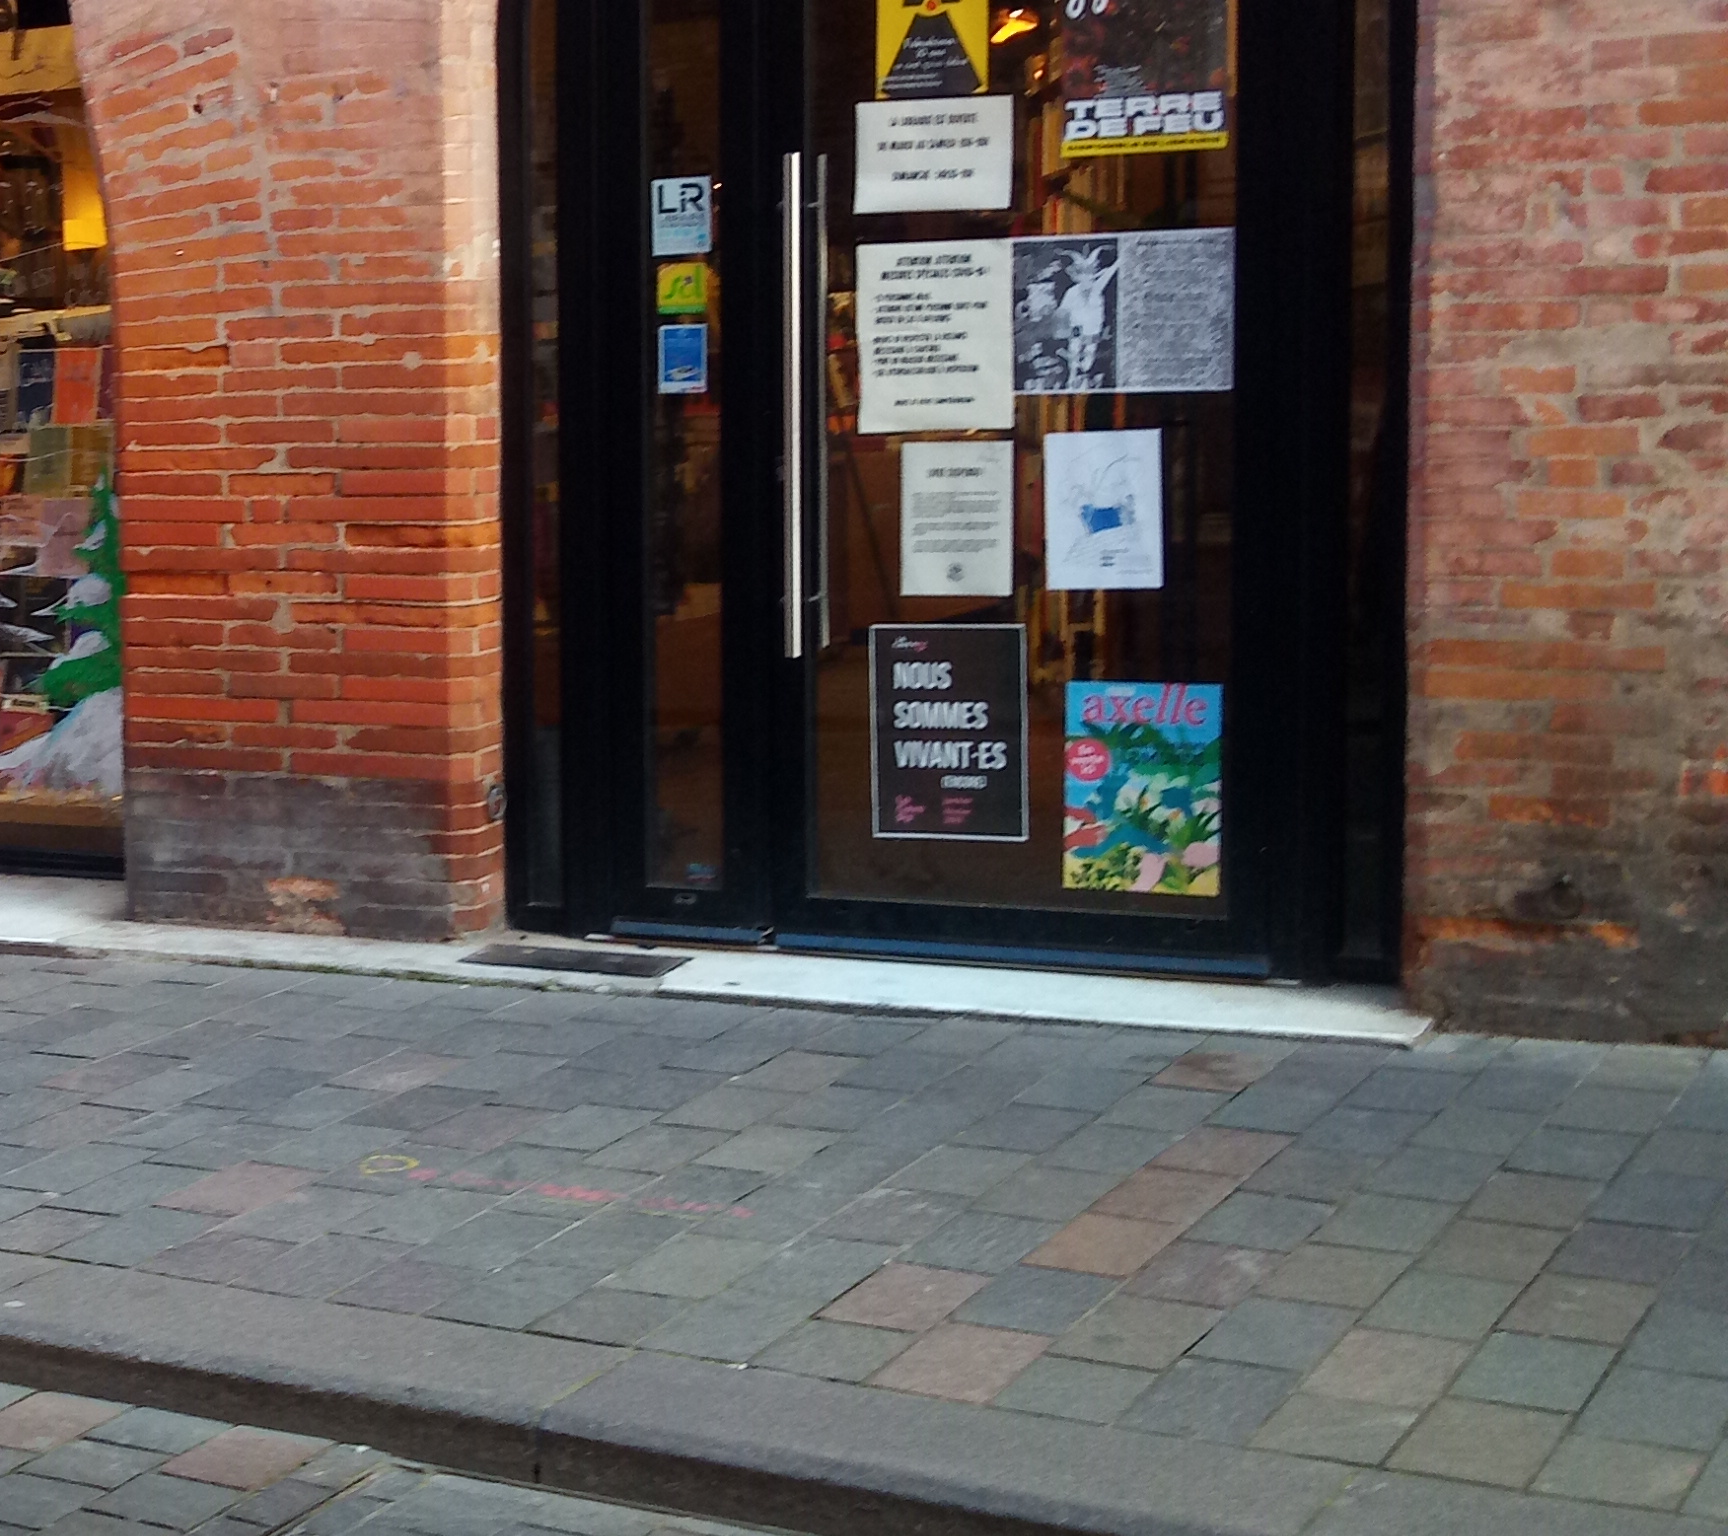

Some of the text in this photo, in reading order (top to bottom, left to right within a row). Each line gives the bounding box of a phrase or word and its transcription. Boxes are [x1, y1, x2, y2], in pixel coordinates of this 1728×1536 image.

[1065, 90, 1223, 121] TERRE
[1064, 110, 1225, 142] DE FEU
[892, 661, 953, 690] NOUS
[893, 700, 990, 730] SOMMES
[1082, 682, 1208, 727] axelle
